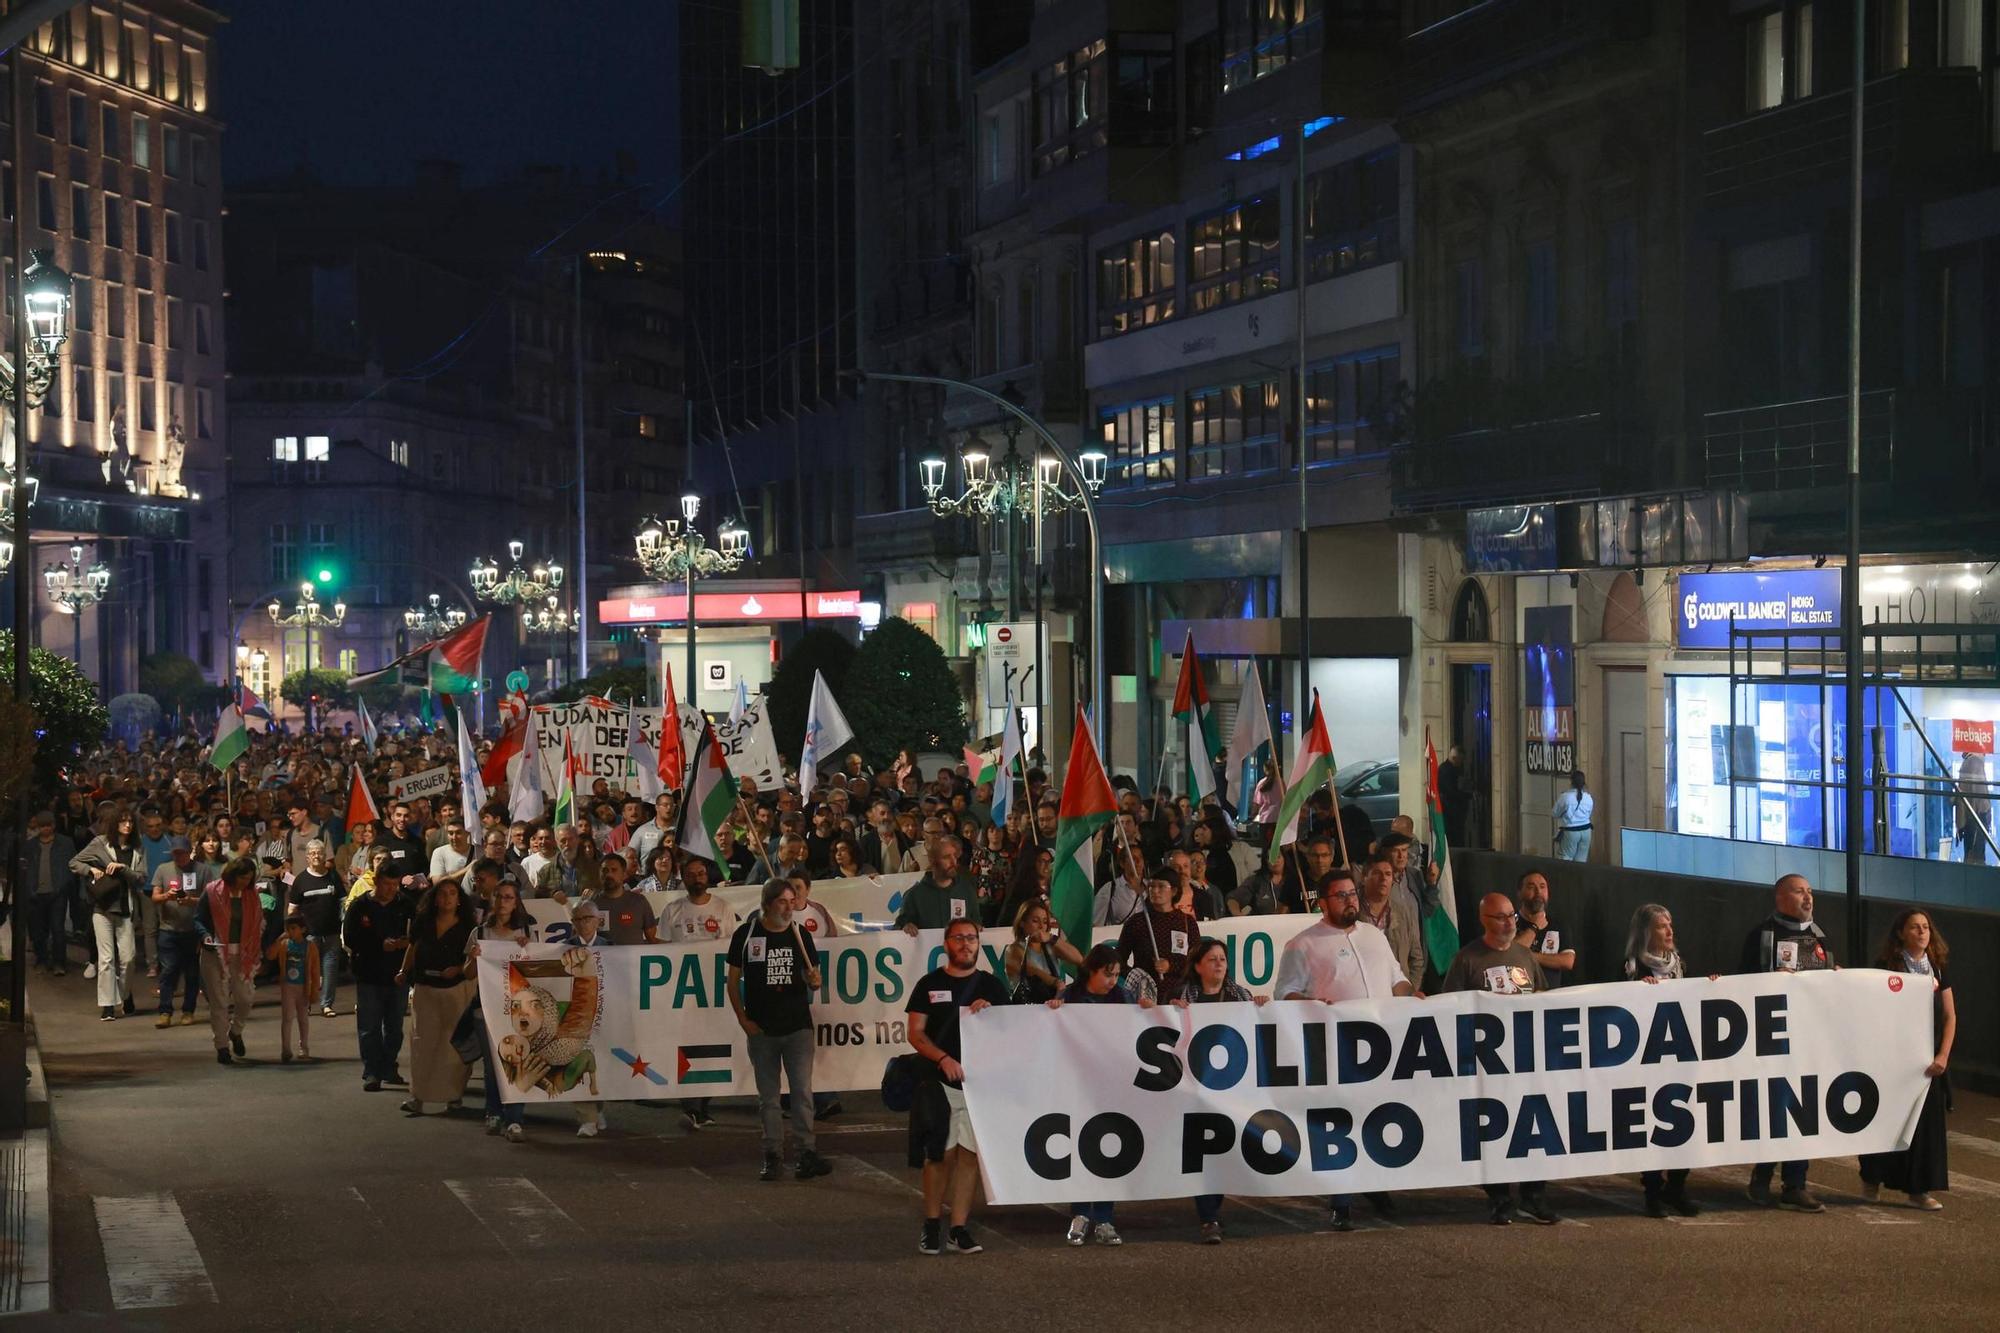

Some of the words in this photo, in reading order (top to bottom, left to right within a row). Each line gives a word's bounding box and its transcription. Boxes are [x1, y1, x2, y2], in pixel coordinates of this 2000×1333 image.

[1699, 602, 1746, 621] COLDWELL
[1748, 601, 1786, 620] BANKER
[1791, 596, 1814, 609] INDIGO
[1791, 612, 1808, 623] REAL
[1809, 610, 1833, 623] ESTATE
[1527, 710, 1569, 738] ALLA
[1954, 727, 1992, 747] #rebajas
[1556, 745, 1572, 773] 058
[406, 773, 446, 796] ERGUER
[767, 957, 793, 967] IMPE
[768, 948, 793, 958] ANTI
[640, 947, 904, 1010] PAOS
[766, 975, 793, 985] ISTA
[767, 966, 793, 976] RIAL
[1133, 994, 1791, 1092] SOLIDARIEDADE
[1024, 1112, 1145, 1180] CO
[1182, 1102, 1424, 1176] POBO
[1460, 1071, 1880, 1162] PALESTINO
